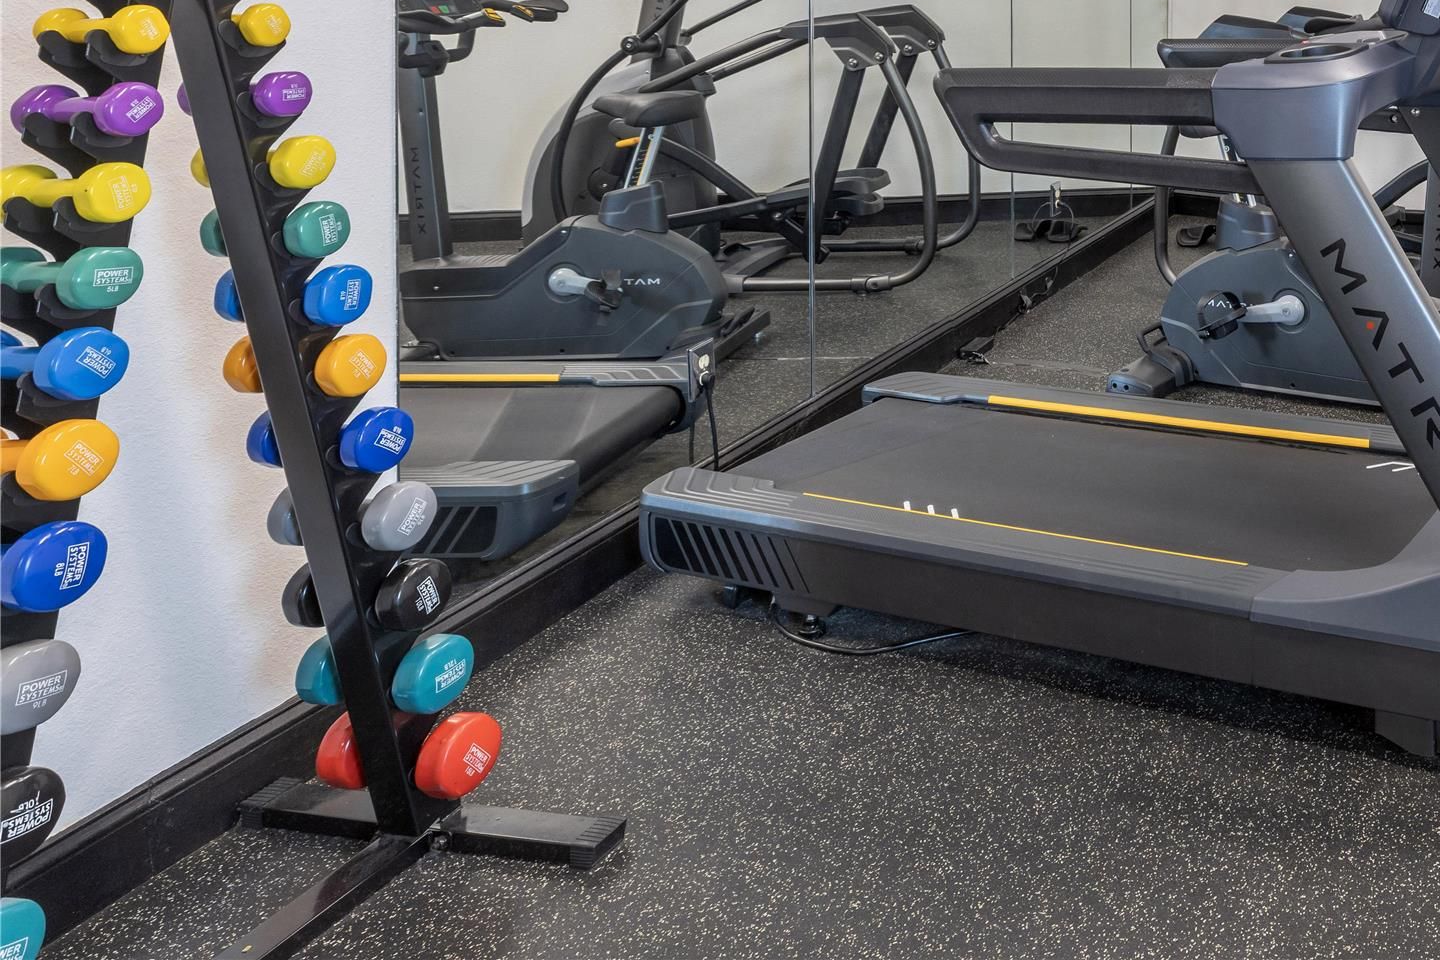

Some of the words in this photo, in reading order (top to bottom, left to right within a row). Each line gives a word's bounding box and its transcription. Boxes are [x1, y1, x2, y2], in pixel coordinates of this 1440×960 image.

[323, 220, 331, 244] POWER
[96, 276, 129, 285] SYSTEMS
[97, 269, 129, 278] POWER
[352, 281, 360, 305] POWER
[82, 356, 109, 376] POWER
[87, 349, 114, 370] SYSTEMS
[357, 350, 374, 371] POWER
[74, 442, 99, 465] POWER
[380, 437, 402, 452] POWER
[68, 450, 95, 474] SYSTEMS
[401, 502, 420, 531] POWER
[65, 547, 79, 584] SYSTEMS
[73, 545, 87, 581] POWER
[424, 580, 438, 603] POWER
[22, 675, 61, 693] POWER
[441, 670, 465, 689] POWER
[20, 685, 60, 703] SYSTEMS
[470, 746, 488, 763] POWER
[7, 812, 49, 838] POWER
[9, 803, 50, 827] SYSTEMS
[0, 943, 22, 959] WER
